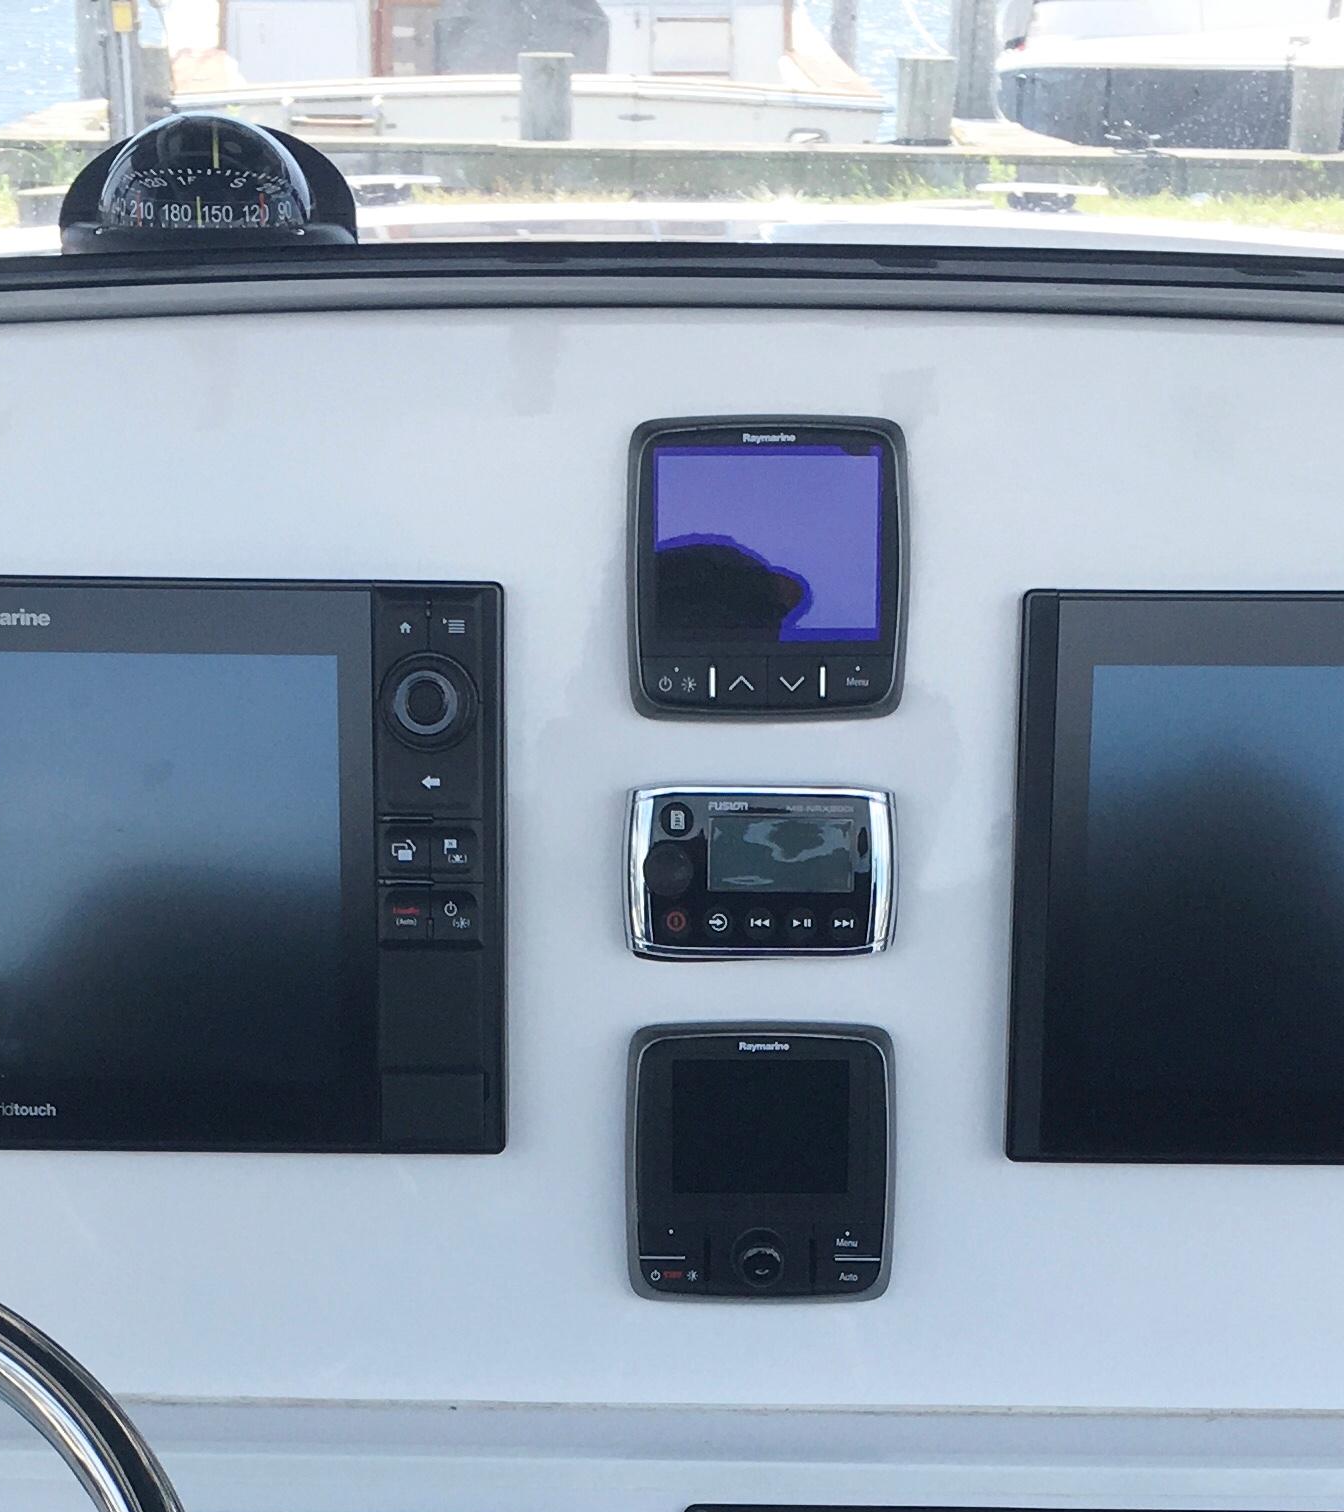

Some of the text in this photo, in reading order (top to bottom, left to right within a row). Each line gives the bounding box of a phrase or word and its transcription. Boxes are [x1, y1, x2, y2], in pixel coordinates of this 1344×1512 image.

[130, 202, 153, 220] 210
[162, 204, 191, 222] 180
[202, 205, 233, 223] 150
[243, 205, 269, 222] 120
[278, 201, 292, 219] 90
[742, 433, 796, 444] Raymarine
[739, 1042, 790, 1052] Raymarine
[836, 1238, 859, 1248] Menu
[839, 1273, 858, 1282] Auto
